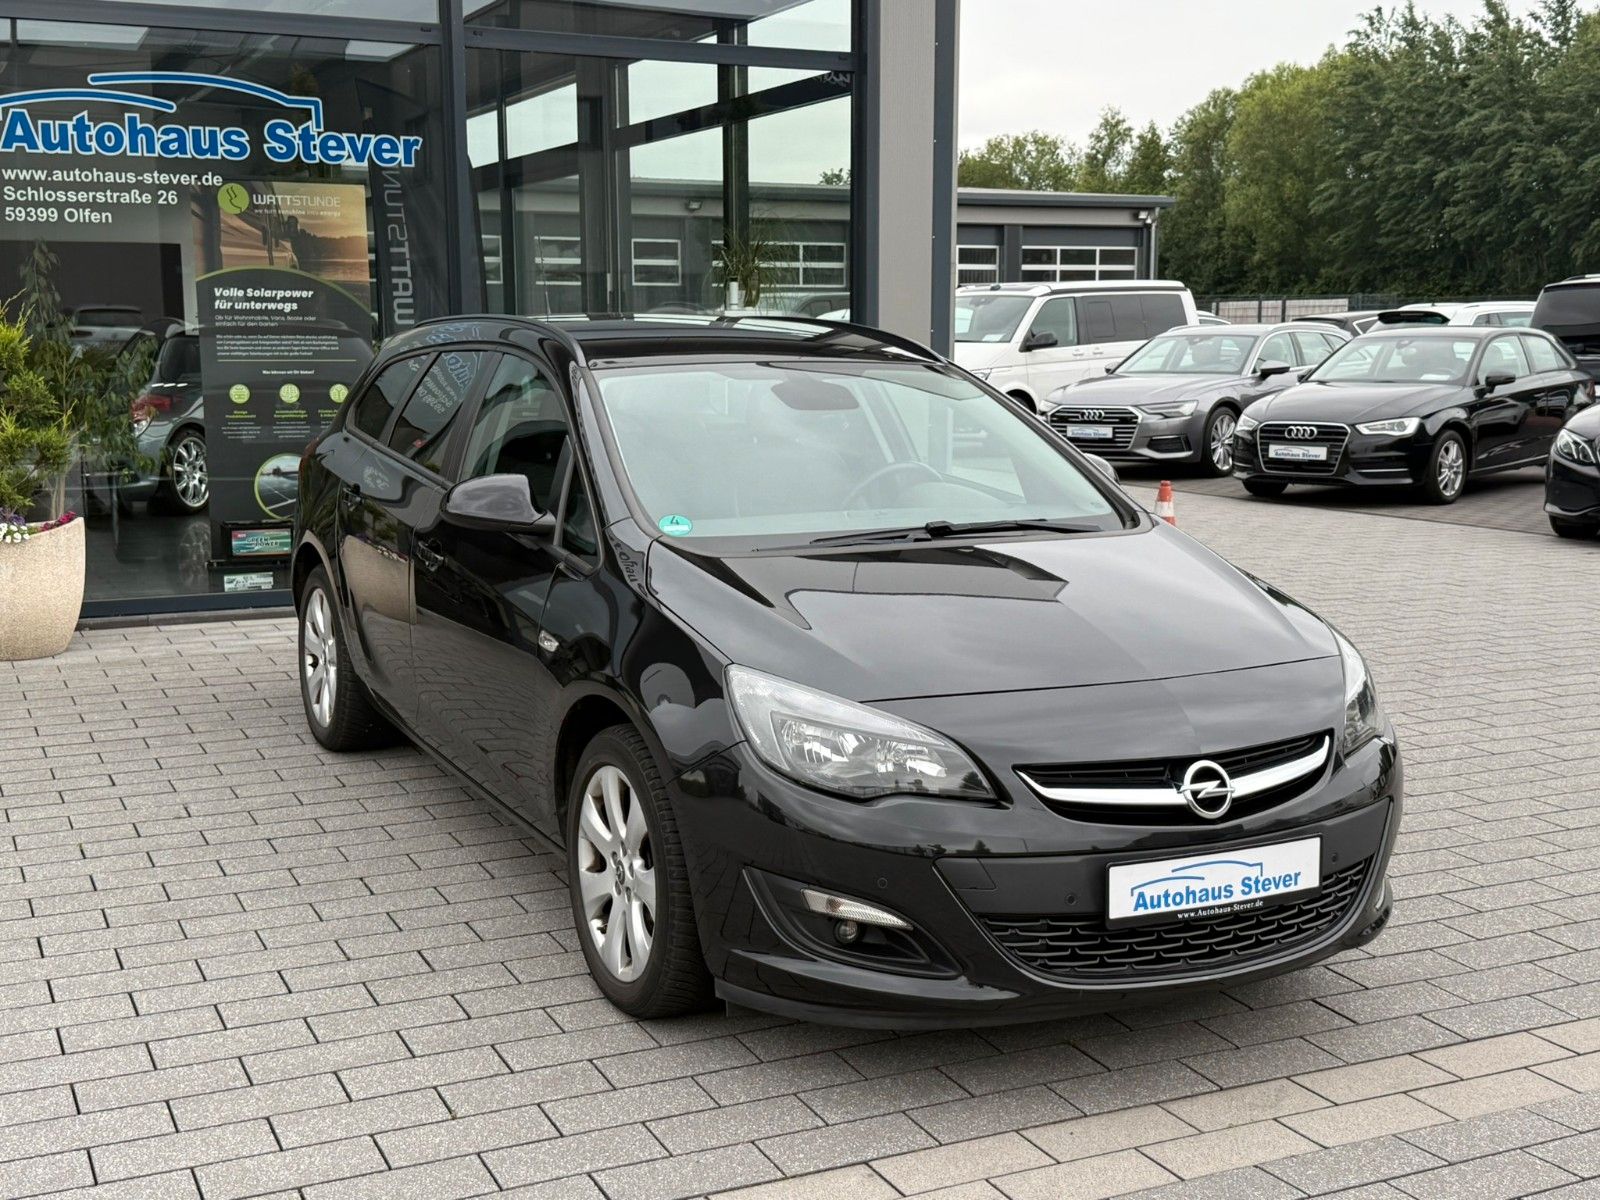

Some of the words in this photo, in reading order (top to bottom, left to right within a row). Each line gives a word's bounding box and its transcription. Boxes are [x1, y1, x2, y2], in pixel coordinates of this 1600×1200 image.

[1, 109, 250, 160] Autohaus
[264, 118, 422, 168] Stever
[2, 168, 223, 186] www.autohaus-stever.de
[3, 186, 152, 204] Schlosserstraße
[157, 190, 178, 205] 26
[252, 194, 341, 208] WATTSTUNDE
[5, 207, 58, 222] 59399
[64, 207, 112, 223] Olfen
[214, 287, 244, 298] Volle
[246, 288, 314, 300] Solarpower
[214, 300, 232, 310] für
[235, 302, 298, 313] unterwegs
[1133, 883, 1233, 912] Autohaus
[1241, 871, 1302, 896] Stever
[1177, 899, 1264, 919] www.Autohaus-Stever.de
